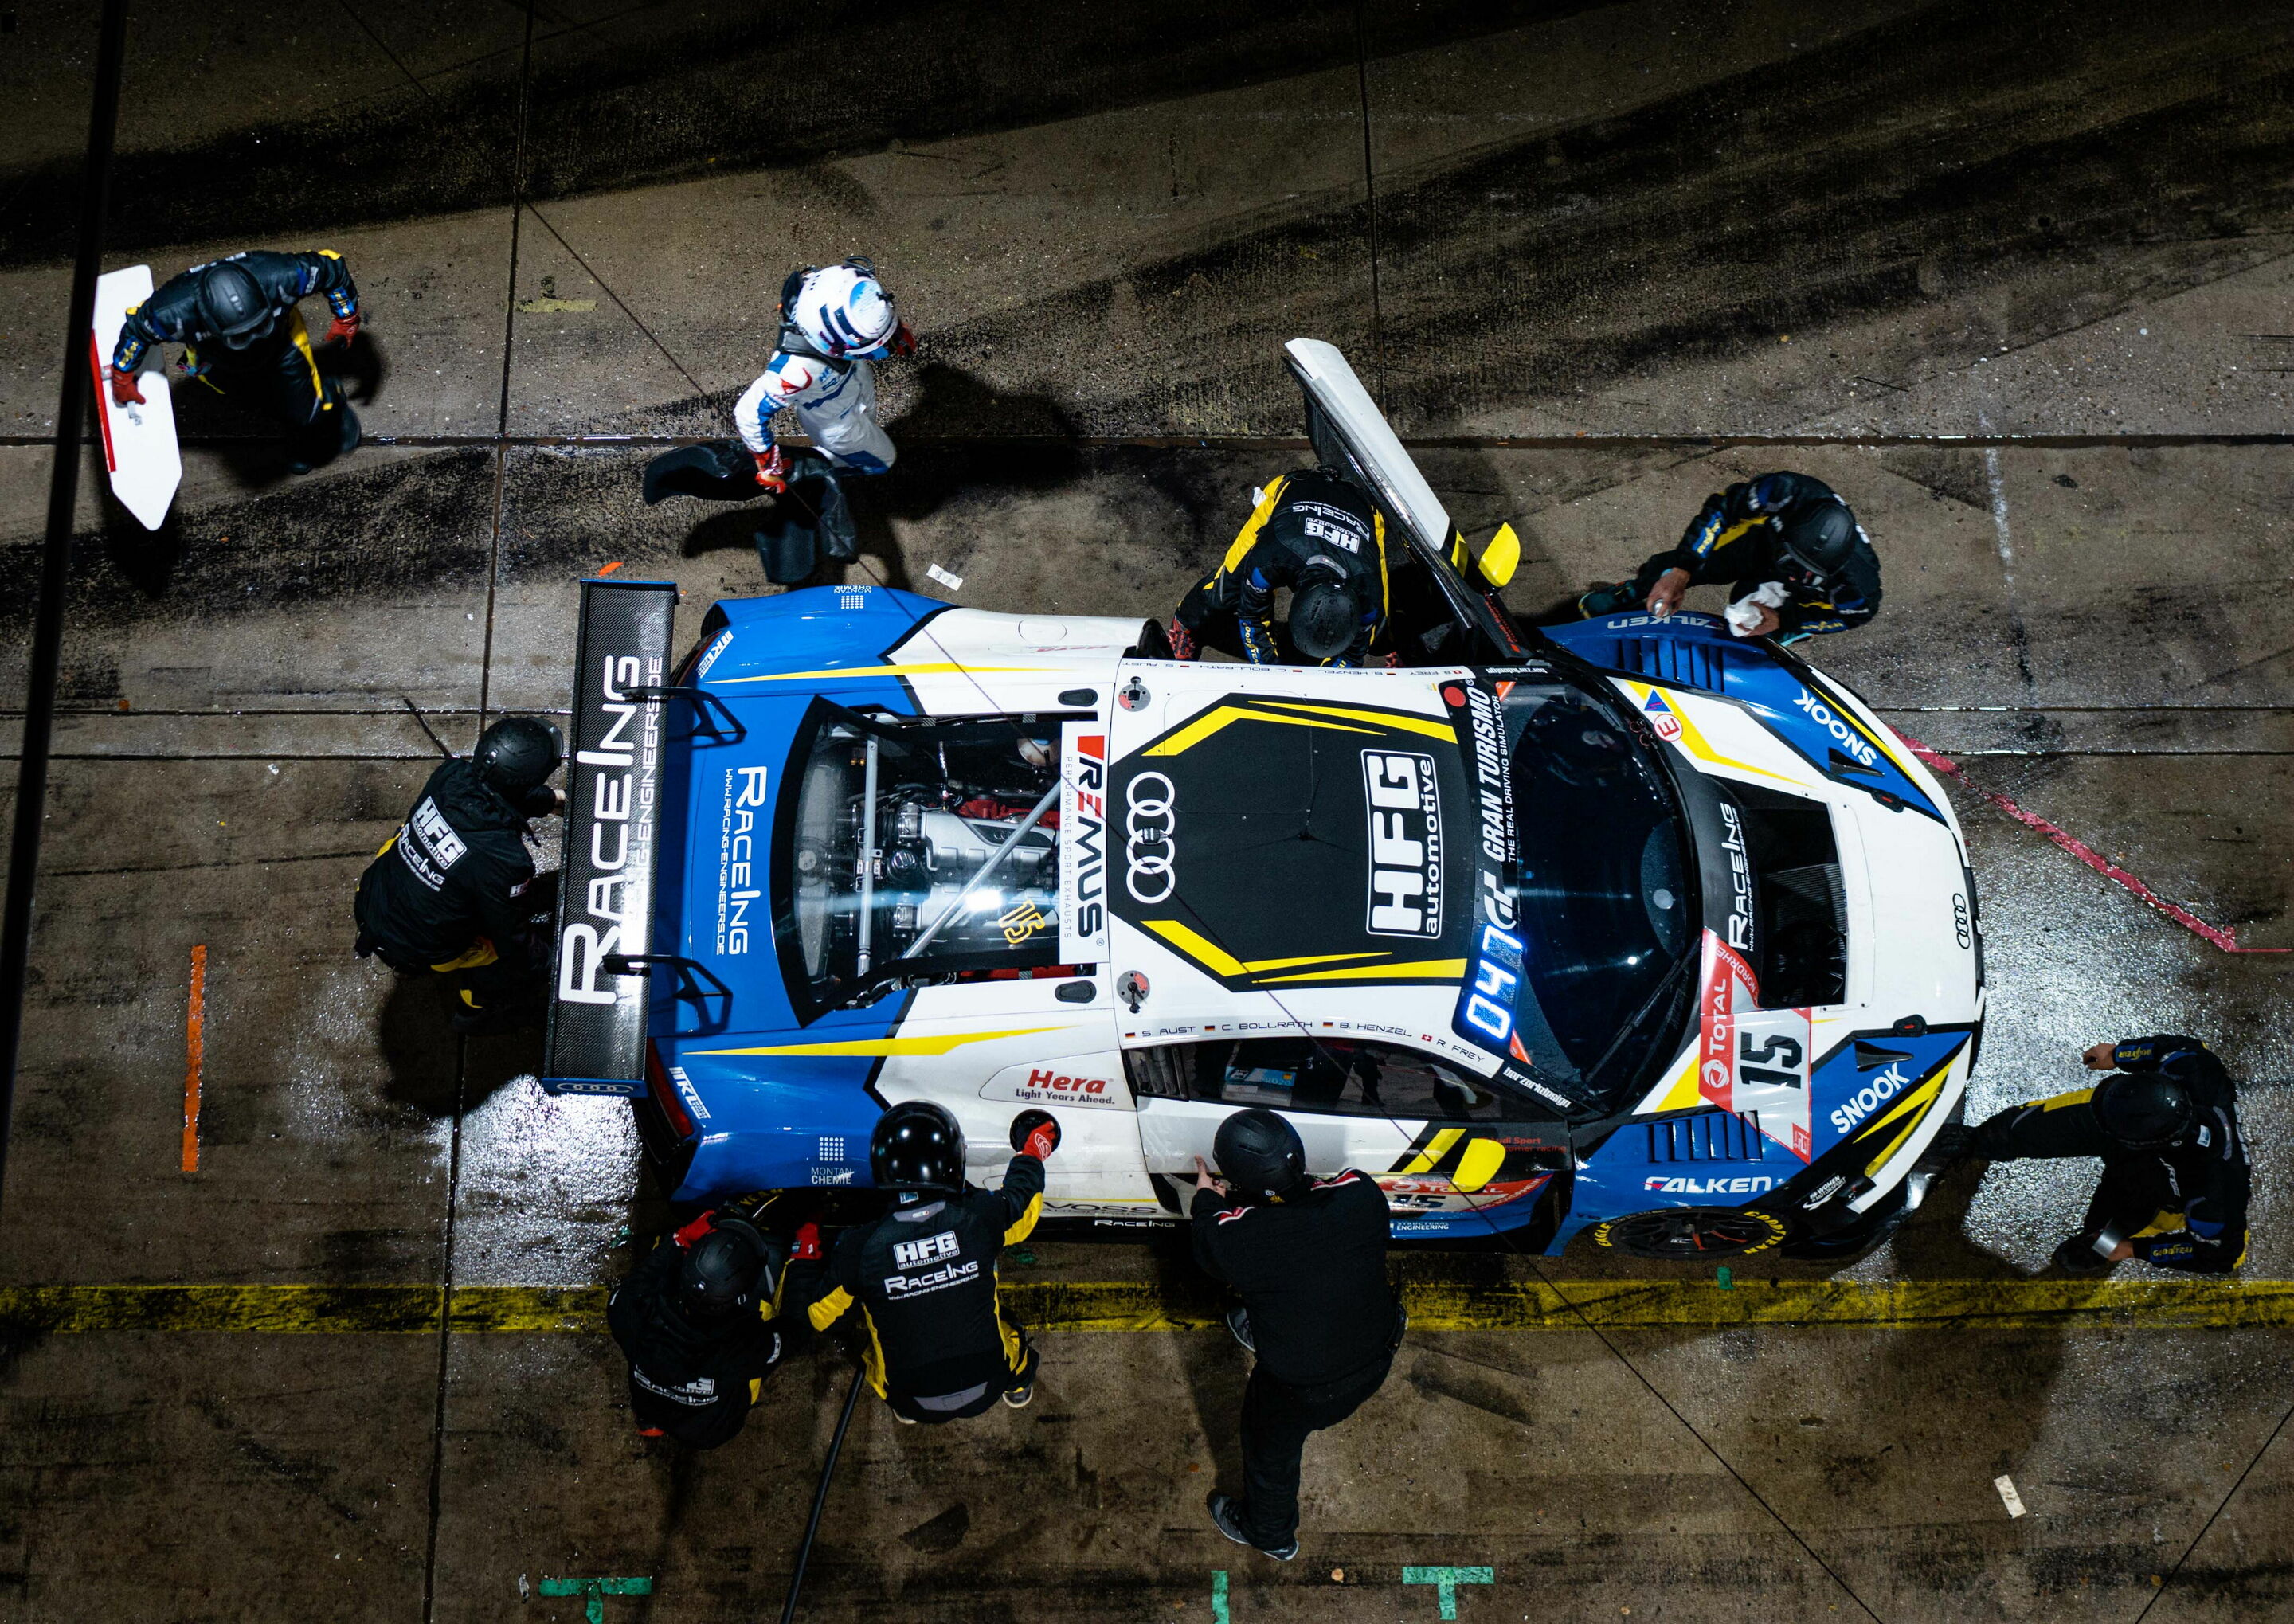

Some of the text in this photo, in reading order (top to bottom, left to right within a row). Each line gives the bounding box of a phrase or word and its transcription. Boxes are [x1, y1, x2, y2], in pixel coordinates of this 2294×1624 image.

[1307, 522, 1359, 553] HFG
[1792, 687, 1878, 767] SNOOK
[1466, 686, 1506, 863] GRAN TURISMO
[1492, 695, 1517, 863] THE REAL DRIVING SIMULATOR
[413, 799, 465, 860] HFG
[1063, 756, 1073, 938] PERFORMANCE SPORT EXHAUSTS
[1075, 756, 1106, 938] REMUS
[1366, 753, 1423, 933] HFG
[1420, 758, 1439, 935] automotive
[997, 899, 1046, 945] 15
[1709, 978, 1728, 1055] TOTAL
[1160, 1026, 1196, 1036] AUST
[1221, 1023, 1233, 1031] C.
[1239, 1020, 1313, 1031] BOLLRATH
[1339, 1021, 1350, 1030] B.
[1356, 1023, 1412, 1038] HENZEL
[1436, 1039, 1446, 1048] R.
[1450, 1043, 1485, 1063] FREY
[1740, 1031, 1803, 1090] 15
[1015, 1087, 1116, 1105] Light Years Ahead.
[1027, 1069, 1106, 1094] Hera
[1830, 1063, 1912, 1134] SNOOK
[1513, 1137, 1542, 1146] Sport
[811, 1167, 853, 1176] MONTAN
[811, 1174, 851, 1185] CHEMIE
[1642, 1176, 1773, 1194] FALKEN
[1393, 1193, 1446, 1208] 15
[895, 1233, 958, 1263] HFG
[1594, 1223, 1613, 1248] EAGLE
[898, 1250, 959, 1268] automotive
